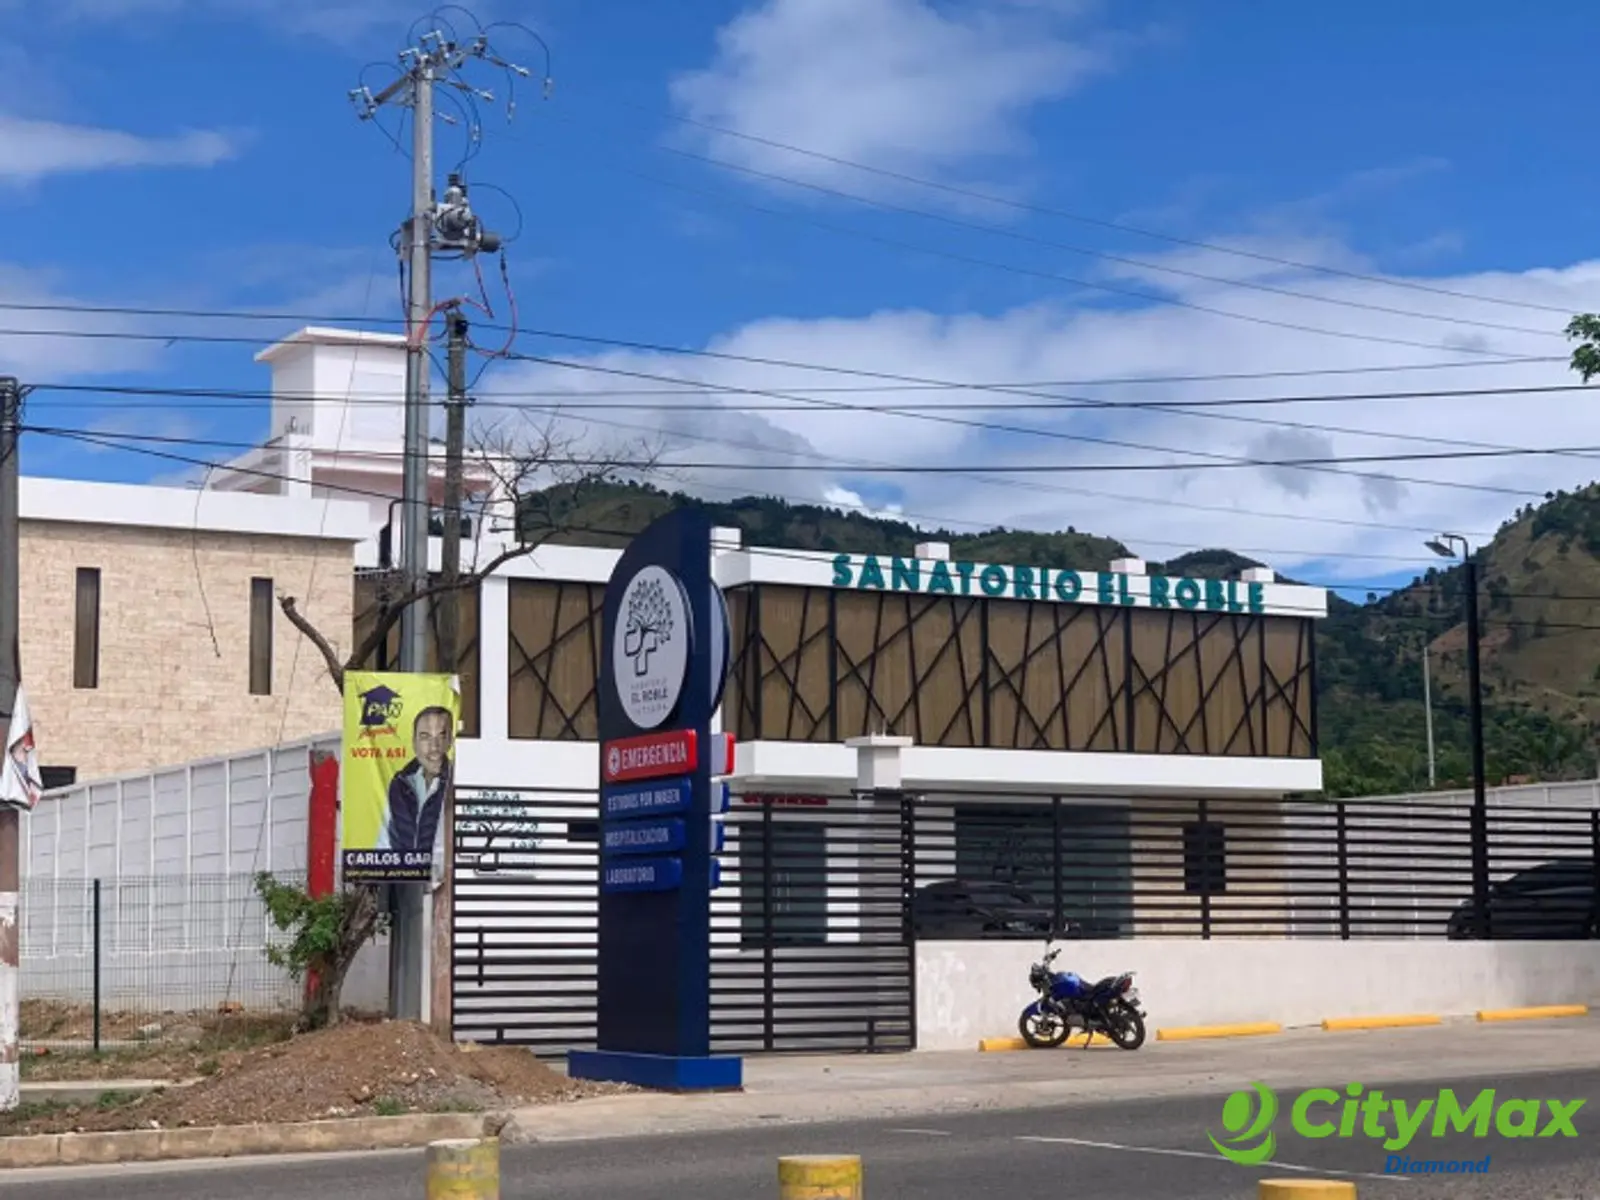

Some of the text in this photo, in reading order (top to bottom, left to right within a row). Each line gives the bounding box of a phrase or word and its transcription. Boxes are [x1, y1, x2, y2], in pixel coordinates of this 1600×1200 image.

[832, 553, 1265, 614] SANATORIO EL ROBLE
[351, 747, 382, 758] VOTA
[622, 741, 687, 770] EMERGENCIA
[346, 851, 401, 866] CARLOS
